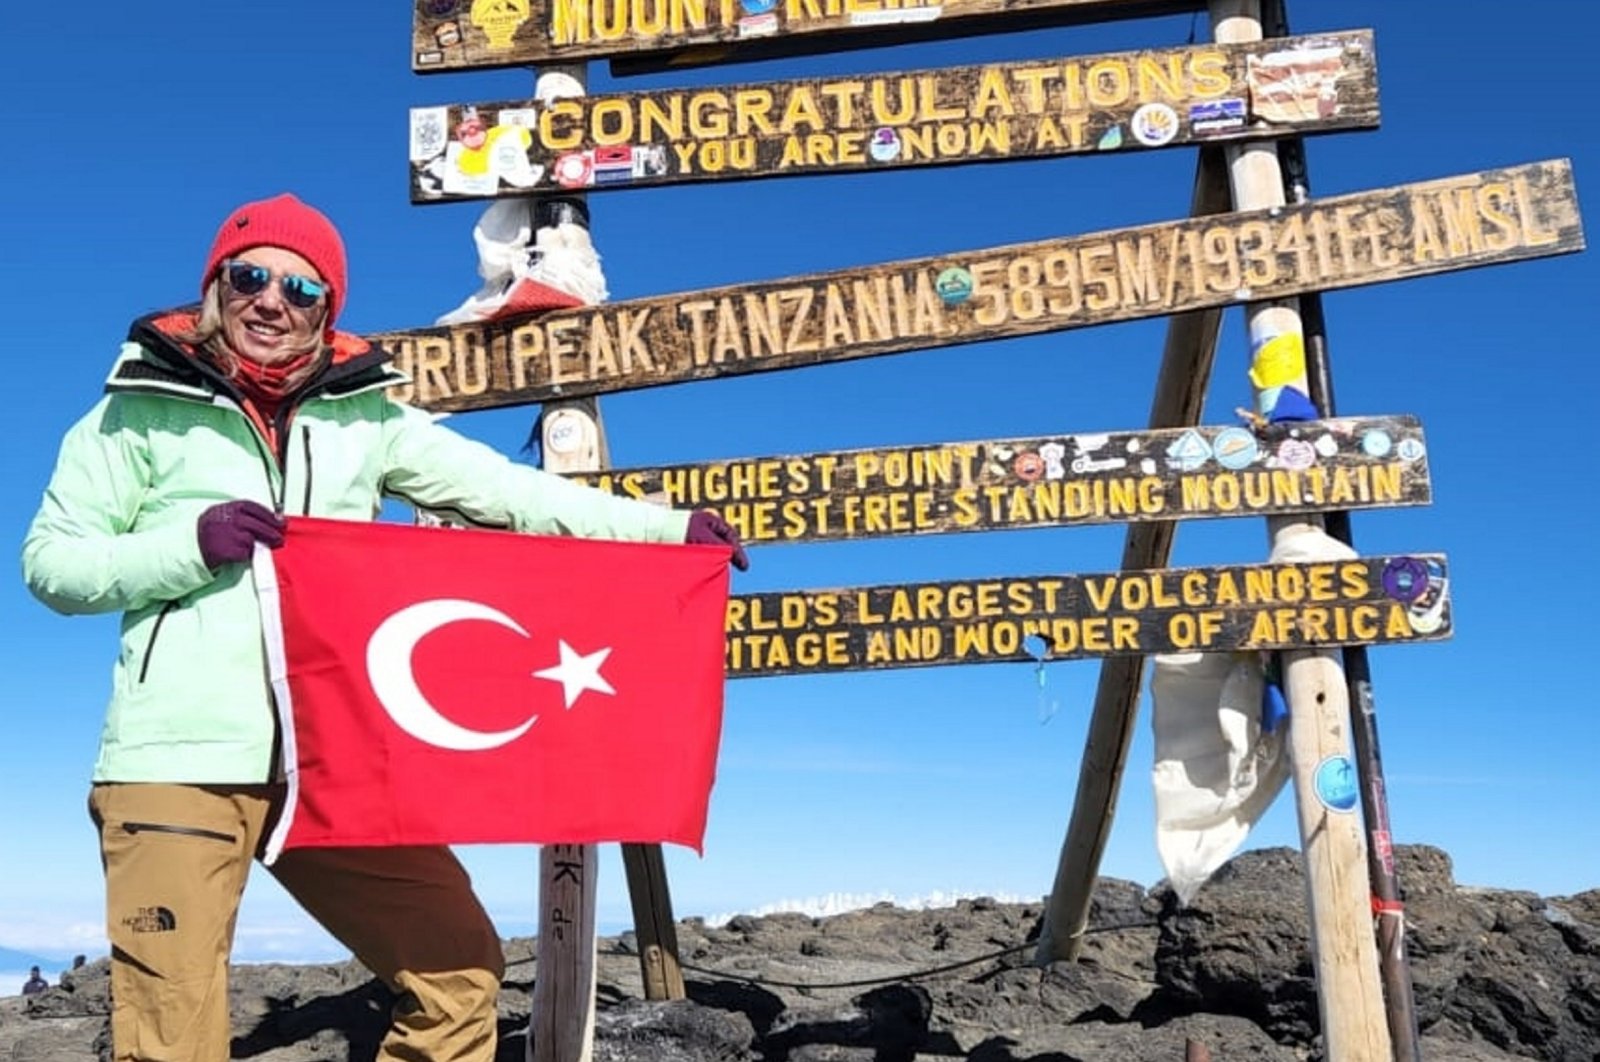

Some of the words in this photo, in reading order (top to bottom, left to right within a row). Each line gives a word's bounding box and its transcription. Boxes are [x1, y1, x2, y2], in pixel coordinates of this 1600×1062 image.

[540, 52, 1231, 150] CONGRATULATIONS
[673, 139, 757, 174] YOU
[779, 132, 867, 169] ARE
[901, 119, 1011, 160] NOW
[1036, 112, 1090, 150] AT
[512, 308, 667, 389] PEAK,
[680, 269, 959, 366] TANZANIA,
[1411, 175, 1559, 263] AMSL
[575, 473, 646, 500] A'S
[662, 457, 838, 503] HIGHEST
[855, 445, 979, 489] POINT
[1182, 462, 1402, 512] MOUNTAIN
[858, 580, 1063, 624] LARGEST
[1083, 562, 1370, 611] VOLCANOES
[724, 632, 850, 669] ITAGE
[866, 625, 941, 662] AND
[1168, 610, 1226, 648] OF
[1249, 604, 1413, 645] AFRICA
